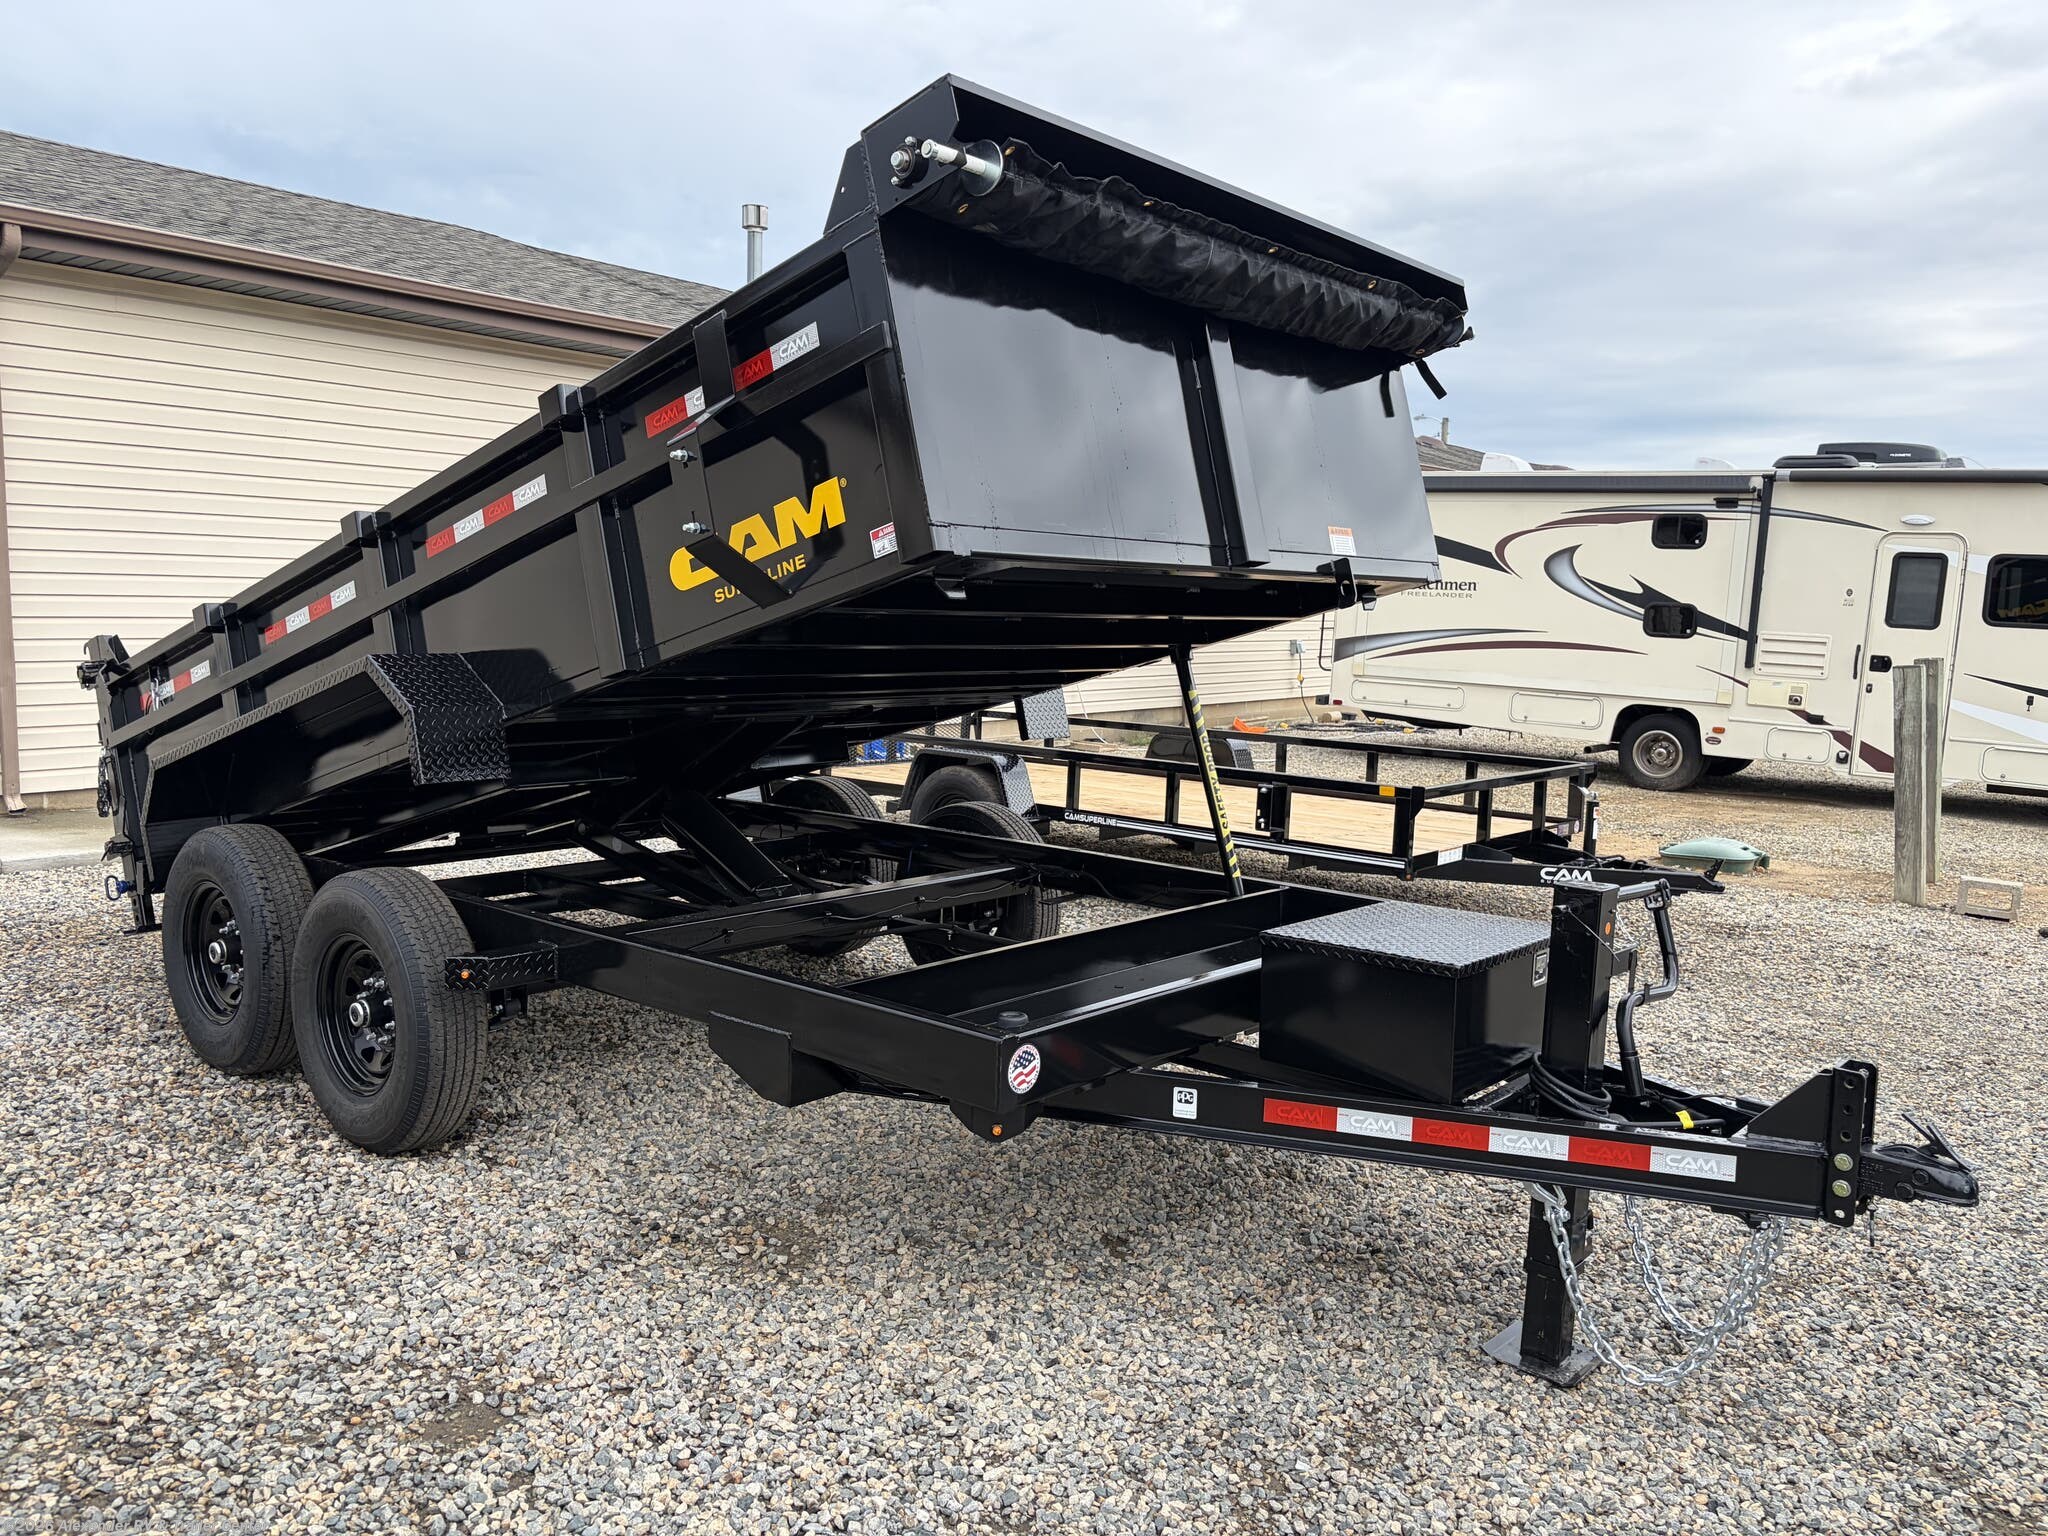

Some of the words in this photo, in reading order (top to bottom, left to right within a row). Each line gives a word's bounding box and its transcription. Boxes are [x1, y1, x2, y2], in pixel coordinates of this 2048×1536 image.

[780, 333, 809, 359] CAM
[653, 407, 679, 427] CAM
[460, 517, 479, 534] CAM
[519, 482, 541, 501] CAM
[714, 554, 807, 604] SULINE
[1400, 591, 1473, 599] FREELANDER
[1211, 776, 1228, 829] SAFETY
[1064, 812, 1117, 826] CAMSUPERLINE
[1540, 867, 1593, 883] CAM
[1177, 1091, 1194, 1104] PPG
[1276, 1106, 1321, 1123] CAM
[1350, 1115, 1396, 1133] CAM
[1426, 1124, 1473, 1143] CAM
[1502, 1134, 1550, 1152] CAM
[1583, 1144, 1633, 1163] CAM
[1665, 1154, 1718, 1174] CAM
